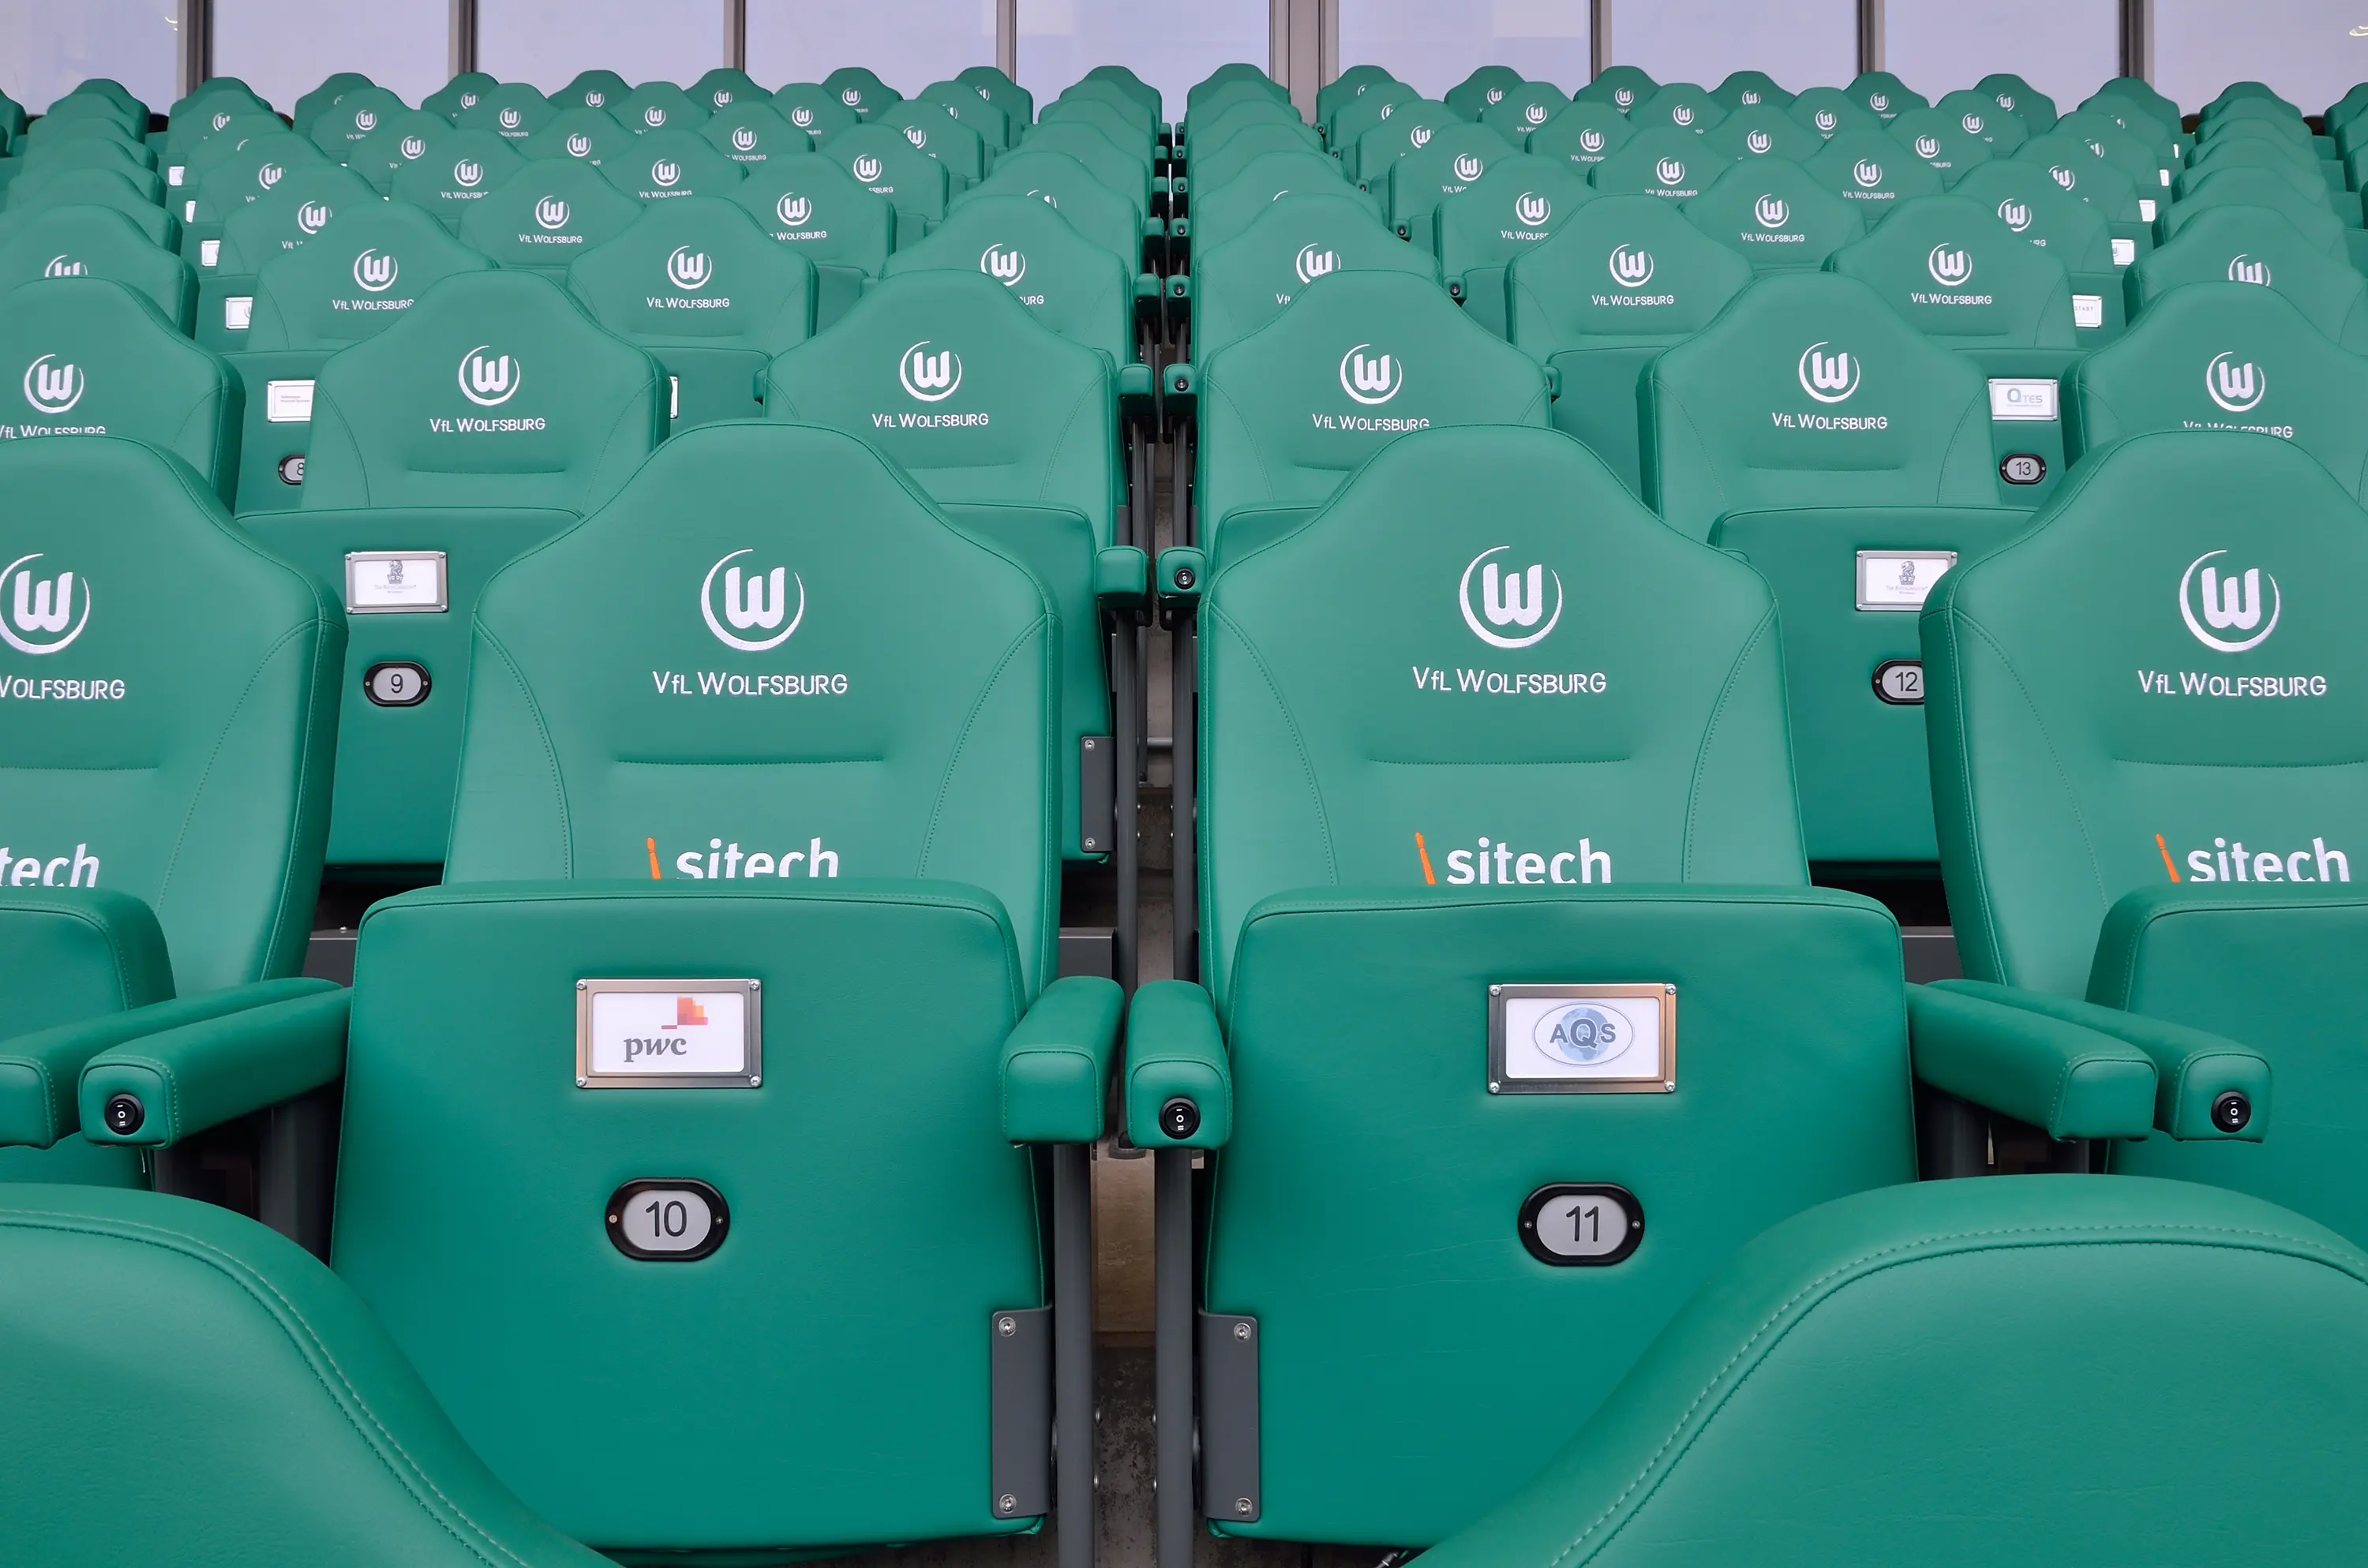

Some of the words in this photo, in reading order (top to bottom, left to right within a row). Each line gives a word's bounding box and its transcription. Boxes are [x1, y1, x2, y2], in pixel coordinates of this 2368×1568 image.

[519, 234, 532, 243] VfL
[534, 234, 583, 243] WOLFSBURG
[777, 230, 827, 240] WOLFSBURG
[1501, 230, 1515, 239] VfL
[1516, 231, 1549, 240] WOLFS
[1741, 233, 1755, 241] VfL
[1755, 234, 1804, 242] WOLFSBURG
[332, 300, 350, 310] VfL
[351, 299, 414, 310] WOLFSBURG
[646, 298, 664, 308] VfL
[665, 298, 729, 309] WOLFSBURG
[1591, 295, 1609, 305] VfL
[1610, 295, 1674, 305] WOLFSBURG
[1911, 293, 1928, 303] VfL
[1929, 294, 1992, 305] WOLFSBURG
[429, 418, 454, 432] VfL
[456, 417, 545, 432] WOLFSBURG
[872, 414, 896, 428] VfL
[898, 414, 989, 428] WOLFSBURG
[1313, 414, 1336, 428] VfL
[1339, 415, 1429, 431] WOLFSBURG
[1772, 413, 1796, 428] VfL
[1798, 414, 1887, 430] WOLFSBURG
[2015, 462, 2032, 477] 13
[391, 674, 403, 694] 9
[653, 671, 692, 694] VfL
[697, 672, 848, 695] WOLFSBURG
[1412, 666, 1452, 690] VfL
[1456, 668, 1606, 694] WOLFSBURG
[1895, 672, 1917, 691] 12
[2138, 670, 2176, 694] VfL
[2179, 672, 2327, 697] WOLFSBURG
[0, 843, 99, 887] tech
[676, 837, 838, 878] sitech
[1447, 837, 1611, 884] sitech
[2188, 837, 2350, 881] sitech
[1549, 1018, 1617, 1049] AQS
[624, 1038, 687, 1063] pwc
[646, 1200, 687, 1237] 10
[1566, 1206, 1598, 1242] 11
